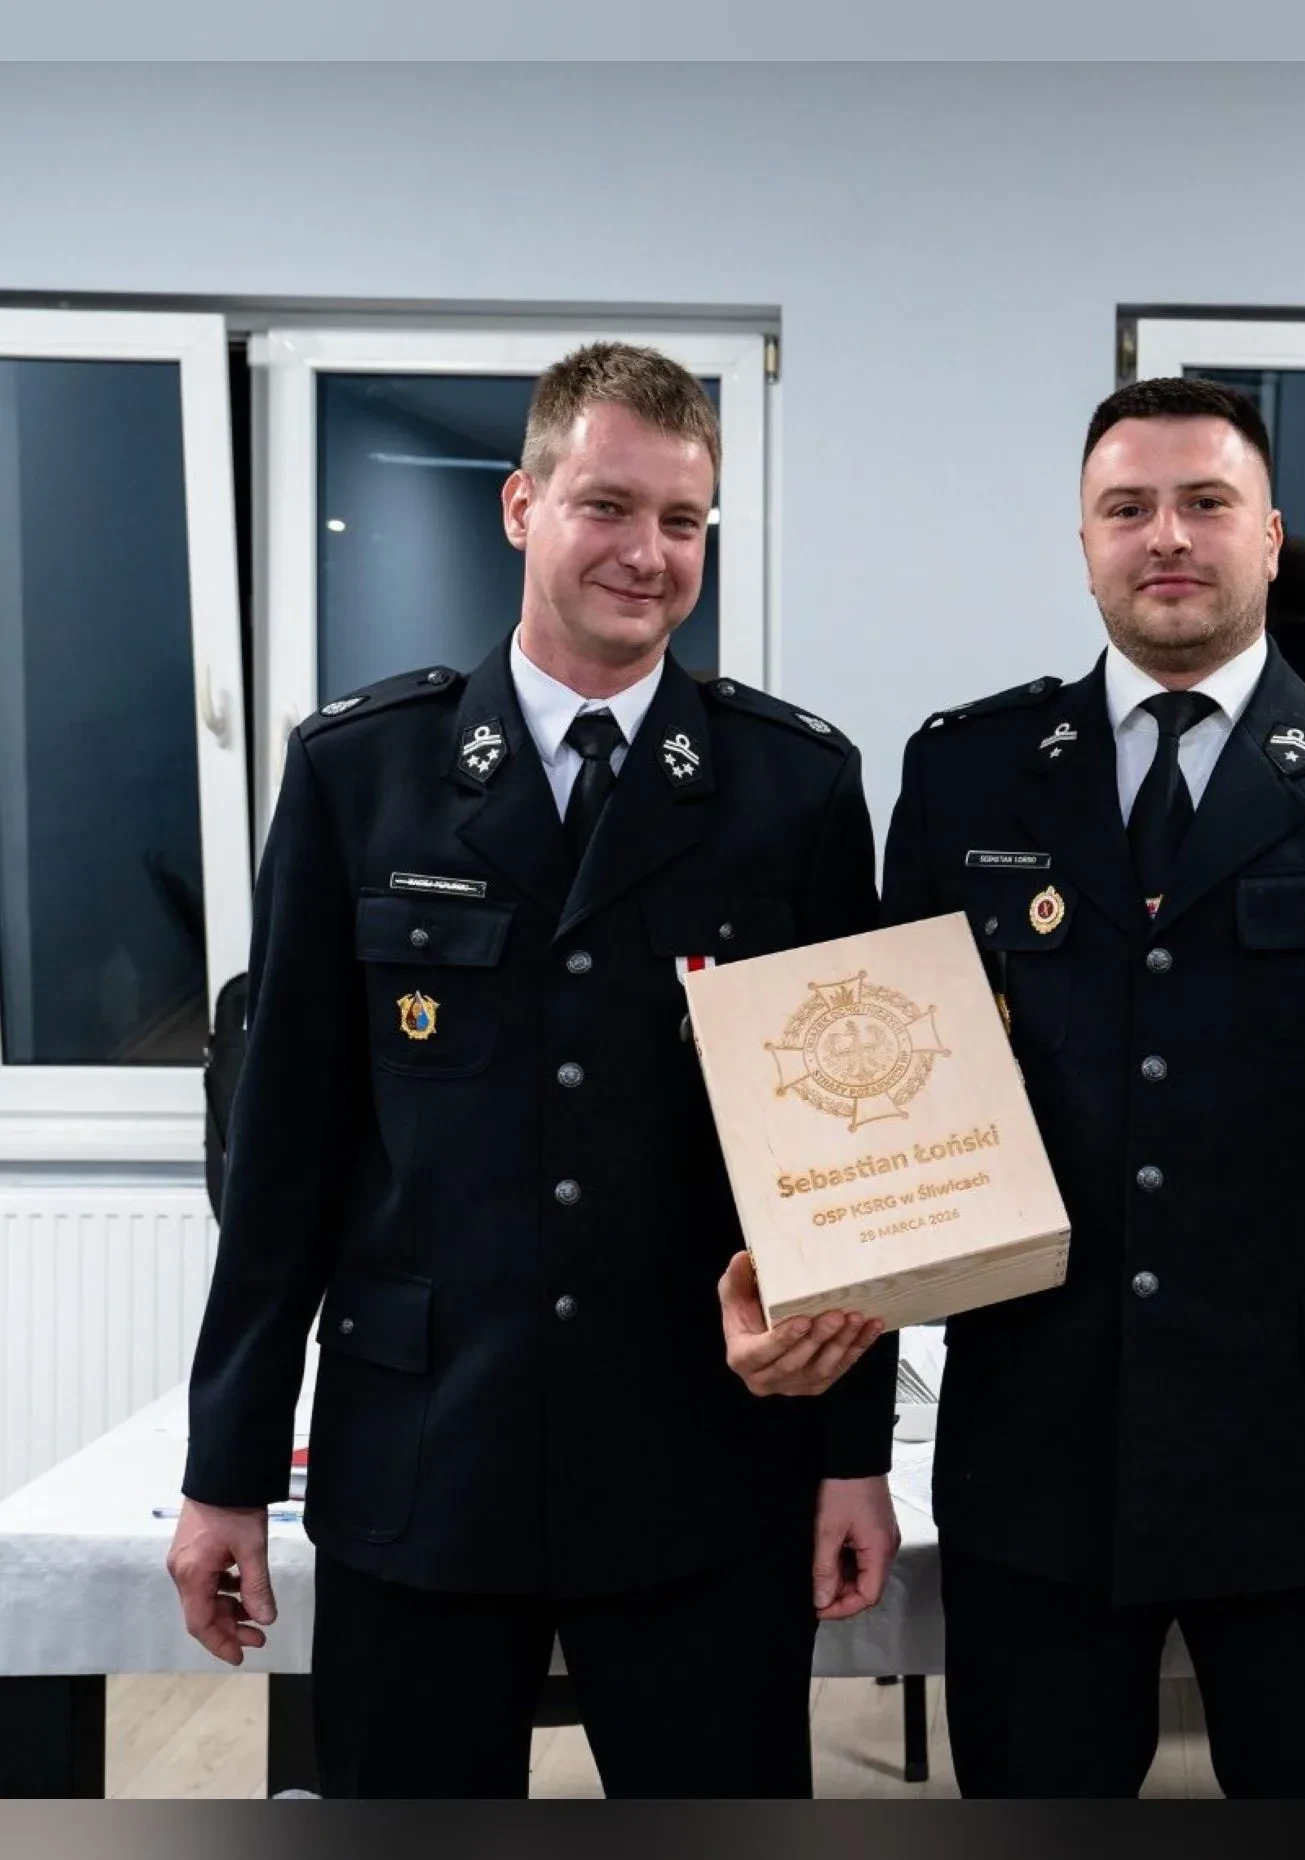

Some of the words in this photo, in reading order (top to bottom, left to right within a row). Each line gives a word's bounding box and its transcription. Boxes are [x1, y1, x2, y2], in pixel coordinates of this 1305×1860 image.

[776, 1152, 909, 1199] Sebastian
[913, 1123, 1000, 1165] Łoński
[812, 1208, 848, 1227] OSP
[850, 1195, 898, 1219] KSRG
[899, 1193, 916, 1205] w
[917, 1171, 991, 1202] Śliwicach
[878, 1217, 927, 1239] MARCA
